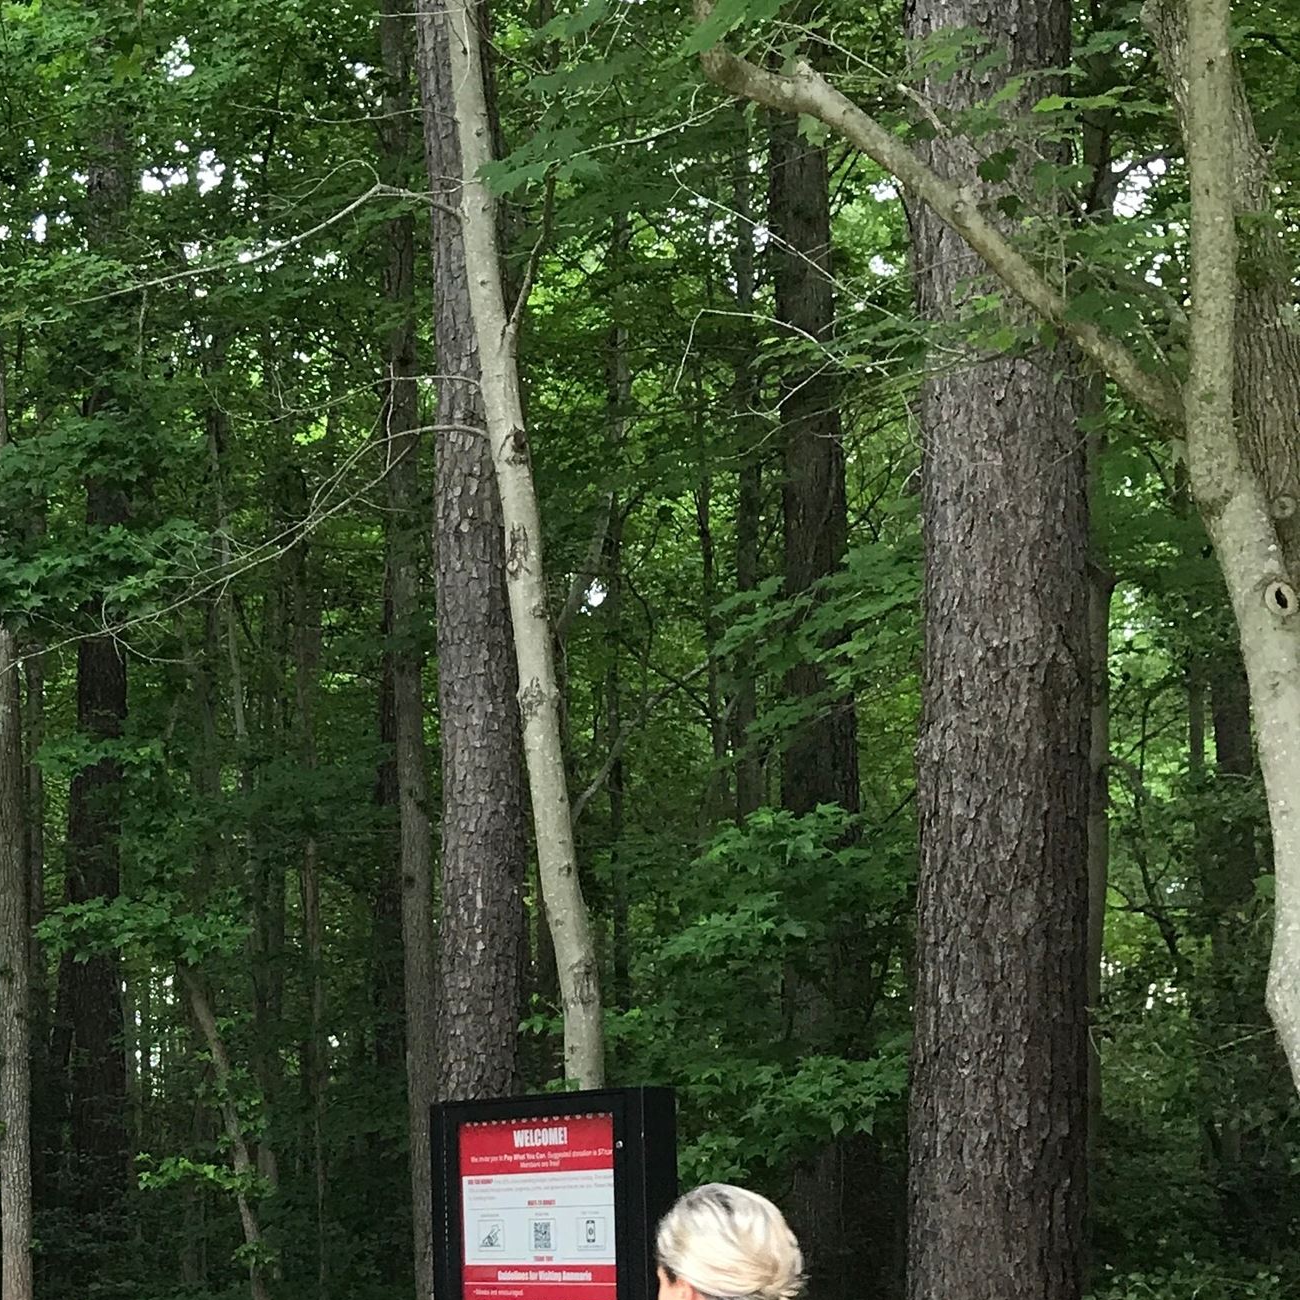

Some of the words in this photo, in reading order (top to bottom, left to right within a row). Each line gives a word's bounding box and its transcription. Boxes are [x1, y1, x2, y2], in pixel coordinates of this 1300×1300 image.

[513, 1127, 567, 1148] WELCOME!
[497, 1270, 529, 1281] Guidelines
[529, 1271, 538, 1281] for
[539, 1271, 562, 1282] Visiting
